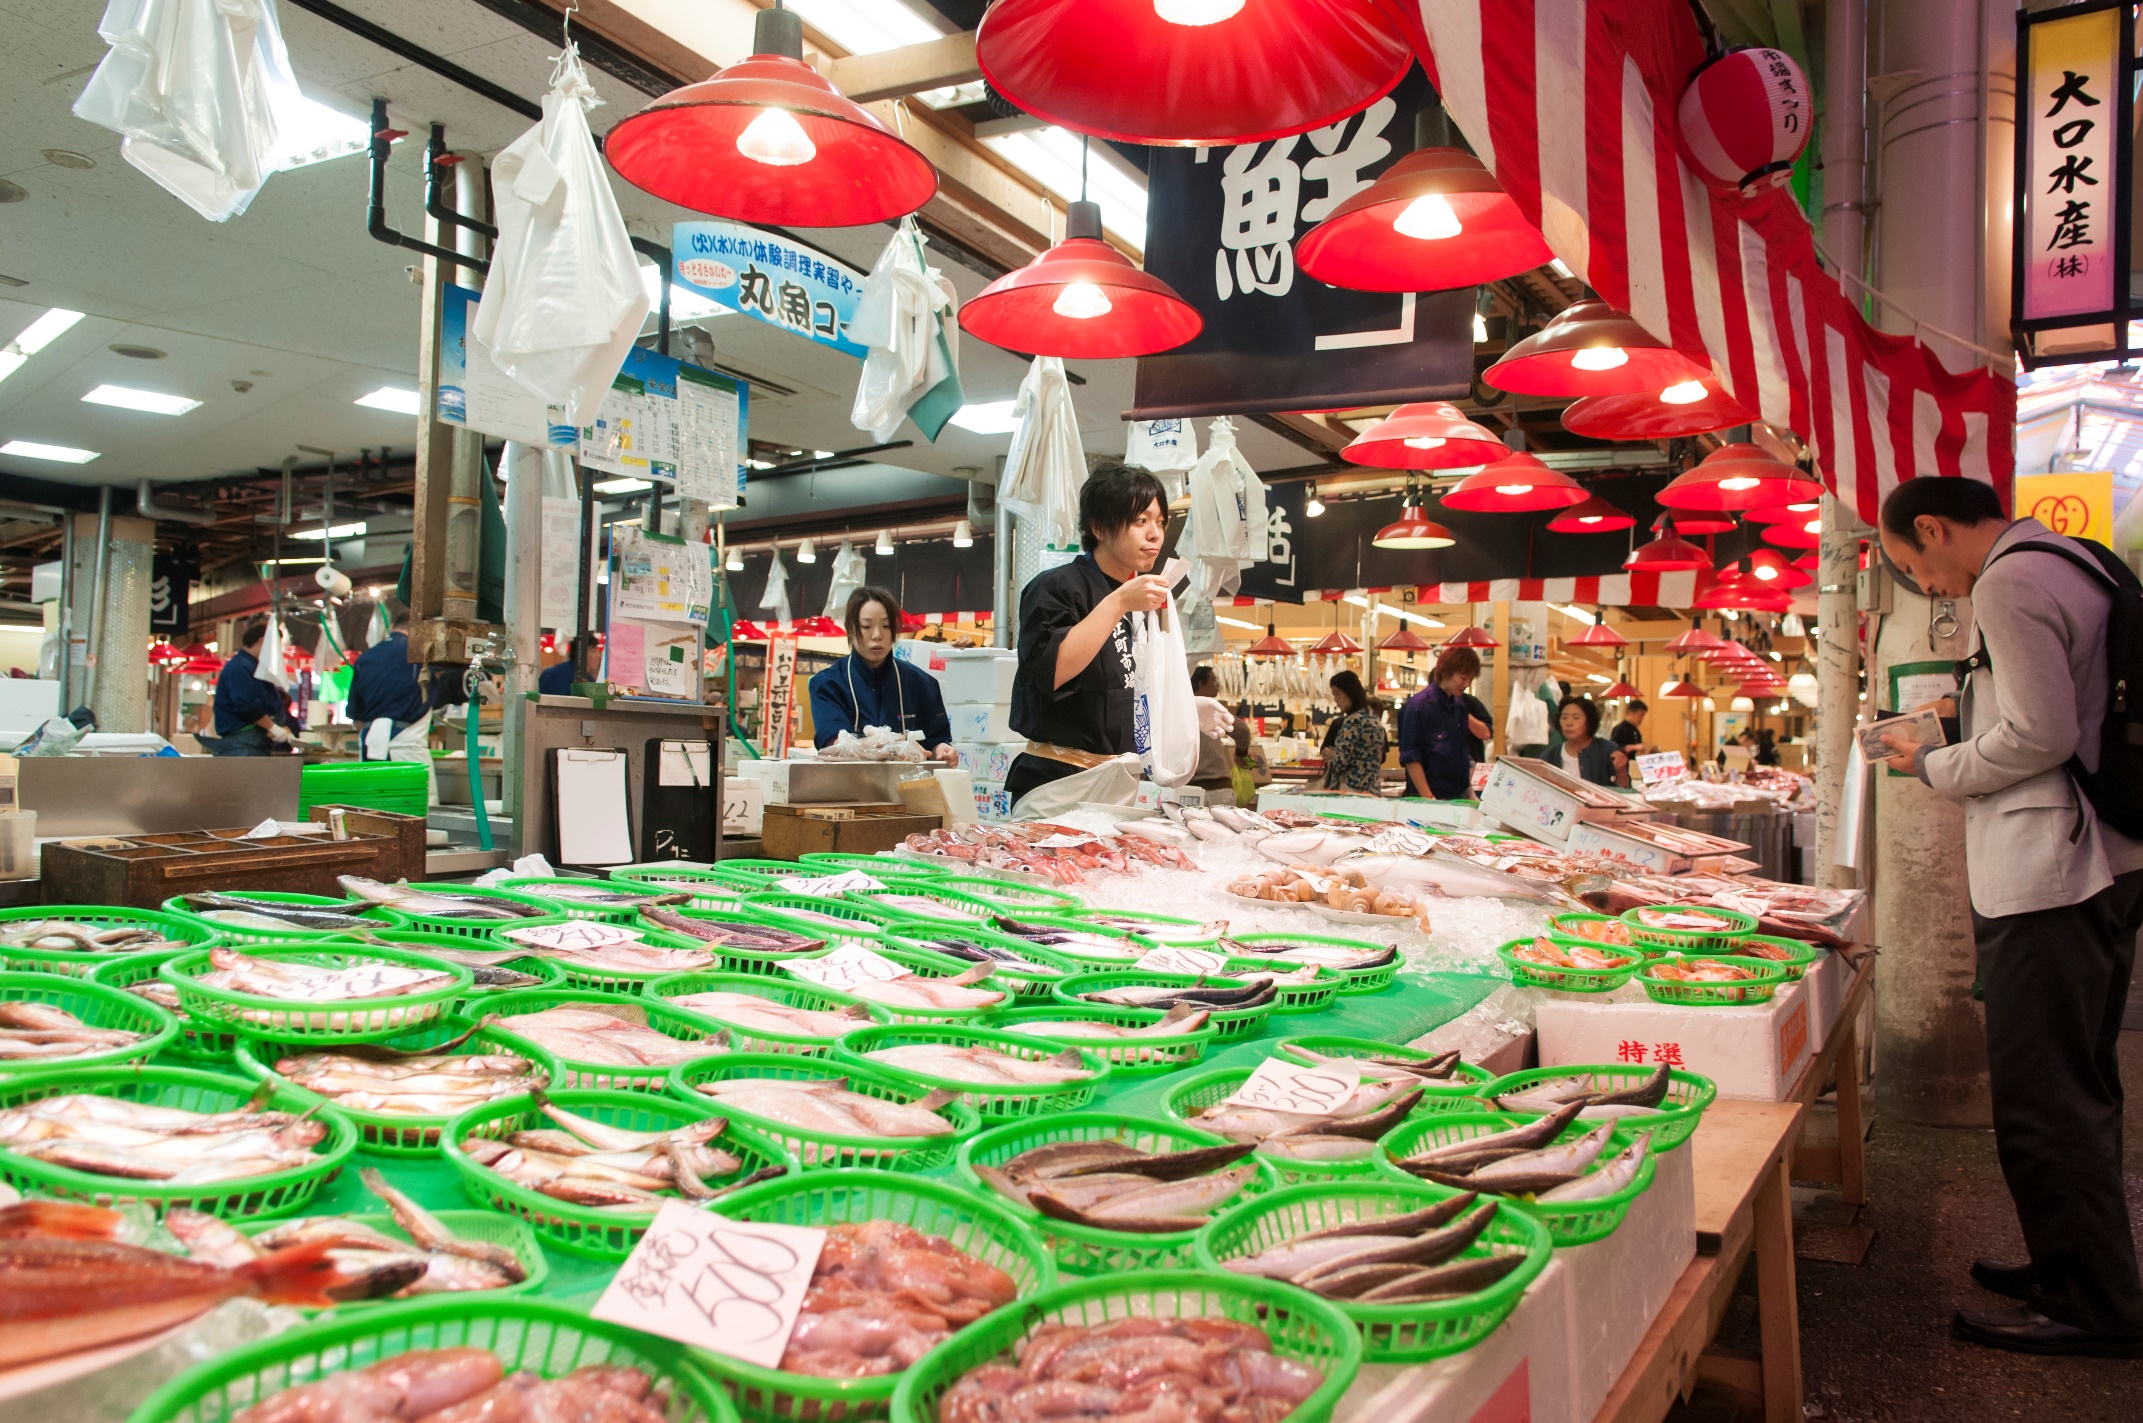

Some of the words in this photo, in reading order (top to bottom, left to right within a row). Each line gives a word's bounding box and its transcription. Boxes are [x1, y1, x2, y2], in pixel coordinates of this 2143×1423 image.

[1617, 1039, 1686, 1065] 特選
[1273, 1073, 1349, 1111] 300
[679, 1228, 800, 1346] 500
